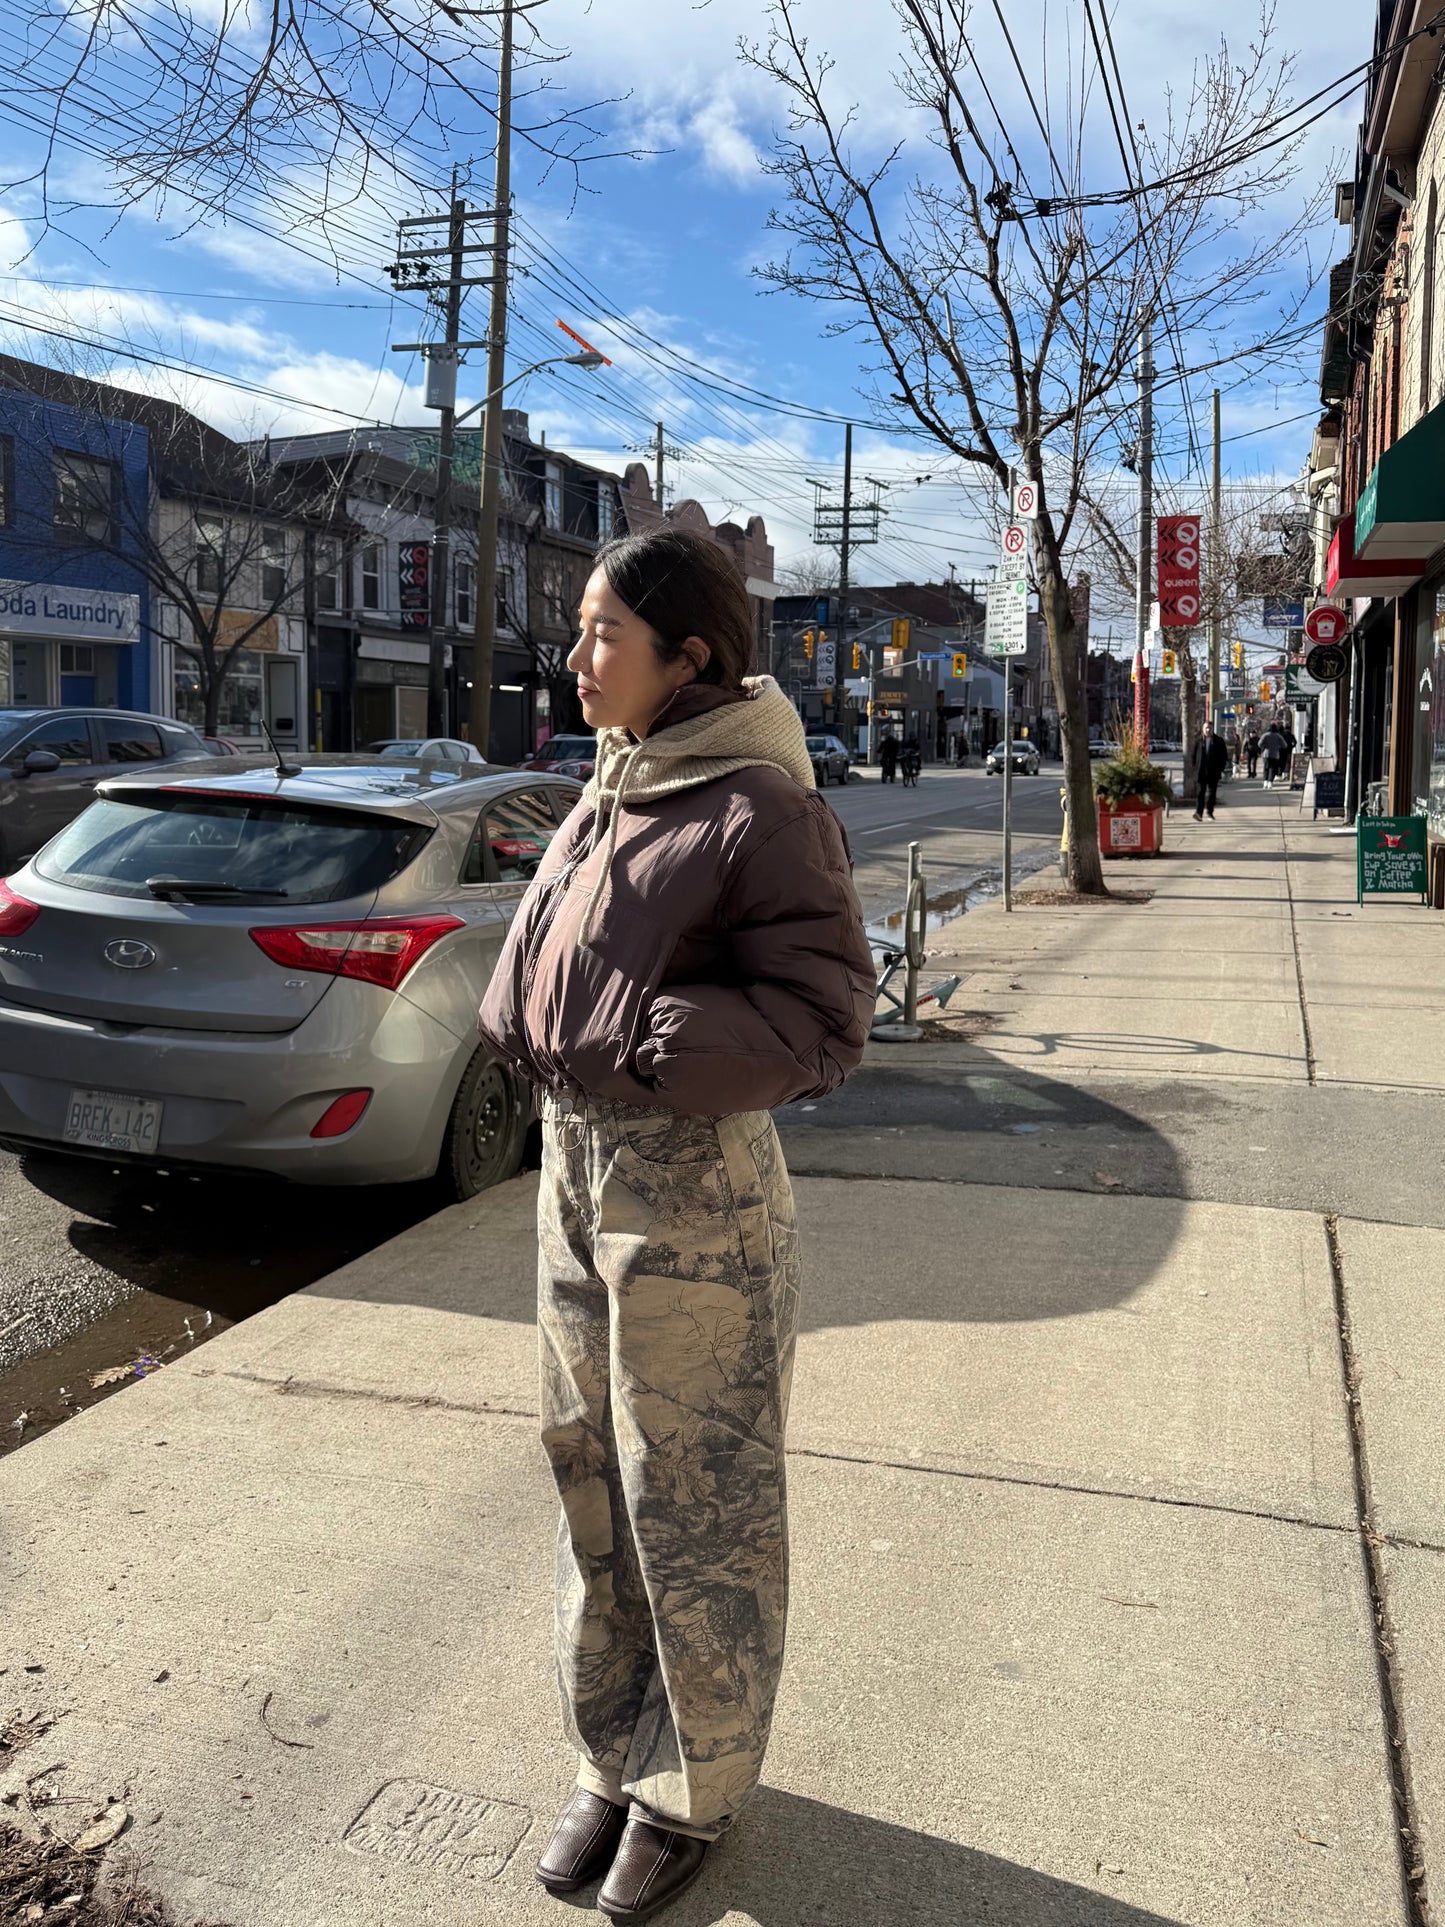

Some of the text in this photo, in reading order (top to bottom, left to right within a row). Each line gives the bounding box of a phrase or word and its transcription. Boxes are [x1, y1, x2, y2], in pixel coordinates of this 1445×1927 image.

[1001, 562, 1026, 572] EXCEPT BY
[44, 596, 125, 629] Laundry
[1380, 870, 1411, 881] Coffee
[1378, 880, 1414, 890] Matcha
[284, 980, 309, 989] GT
